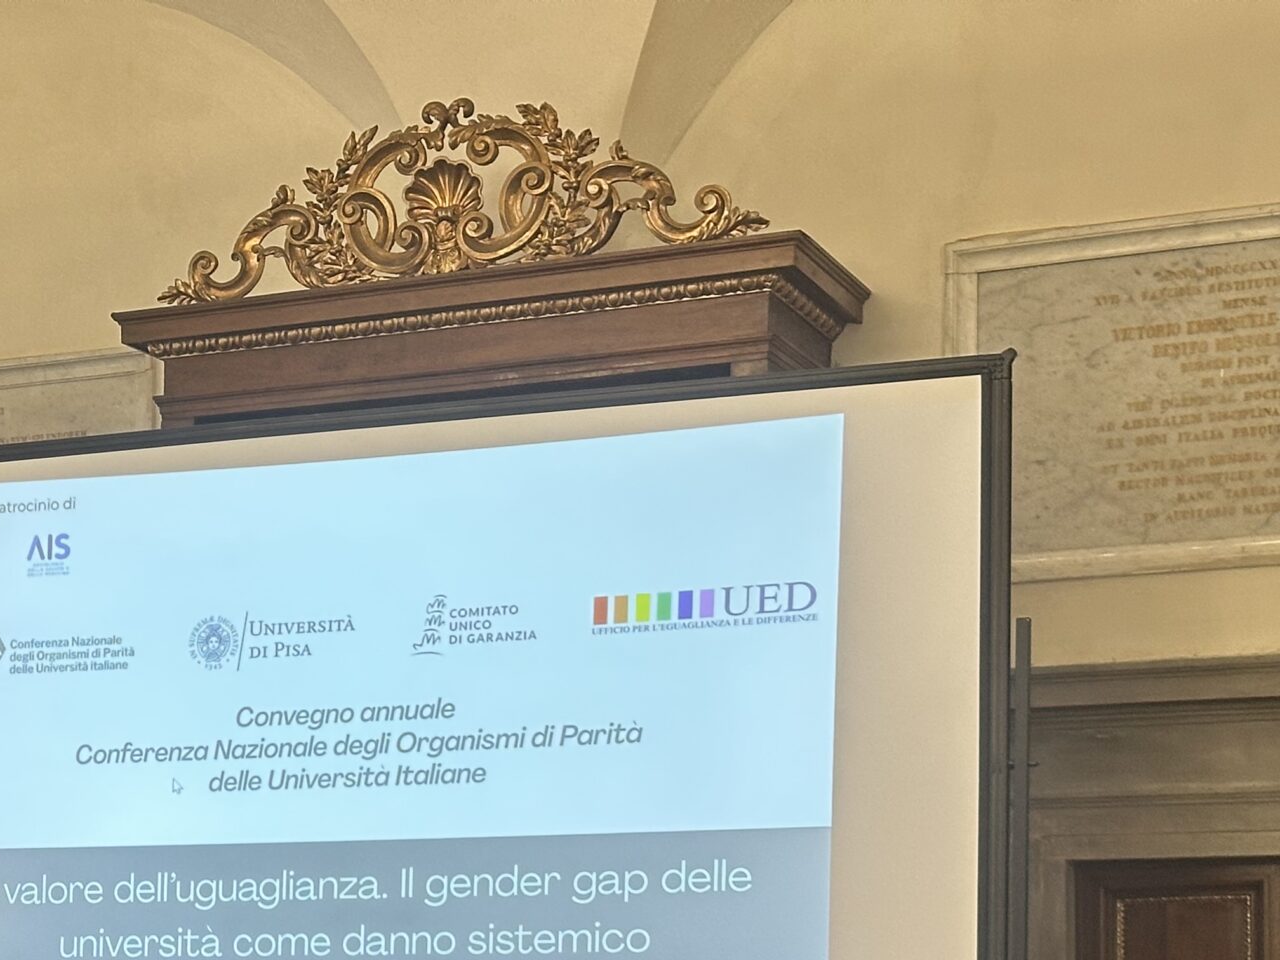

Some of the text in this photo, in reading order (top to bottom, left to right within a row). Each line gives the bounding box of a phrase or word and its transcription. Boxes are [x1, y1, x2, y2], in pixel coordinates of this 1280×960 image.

[1178, 430, 1224, 443] ITALIA
[63, 496, 76, 510] di
[27, 533, 71, 561] AIS
[722, 581, 818, 616] UED
[449, 605, 519, 619] COMITATO
[249, 615, 355, 636] UNIVERSITÀ
[449, 618, 492, 632] UNICO
[591, 612, 818, 636] UFFICIO PER L'EGUAGLIANZA E LE DIFFERENZE
[10, 636, 122, 649] Conferenza Nazionale
[449, 630, 537, 645] DI GARANZIA
[10, 647, 135, 663] degli Organismi di Parità
[10, 664, 34, 674] delle
[36, 662, 88, 673] Università
[236, 697, 455, 730] Convegno annuale
[76, 721, 643, 765] Conferenza Nazionale degli Organismi di Parità
[209, 763, 487, 792] delle Università Italiane
[4, 874, 104, 904] valore
[114, 870, 387, 910] dell'uguaglianza.
[401, 867, 413, 898] Il
[424, 864, 561, 907] gender
[572, 870, 648, 904] gap
[661, 859, 752, 893] delle
[60, 921, 650, 958] università come danno sistemico
